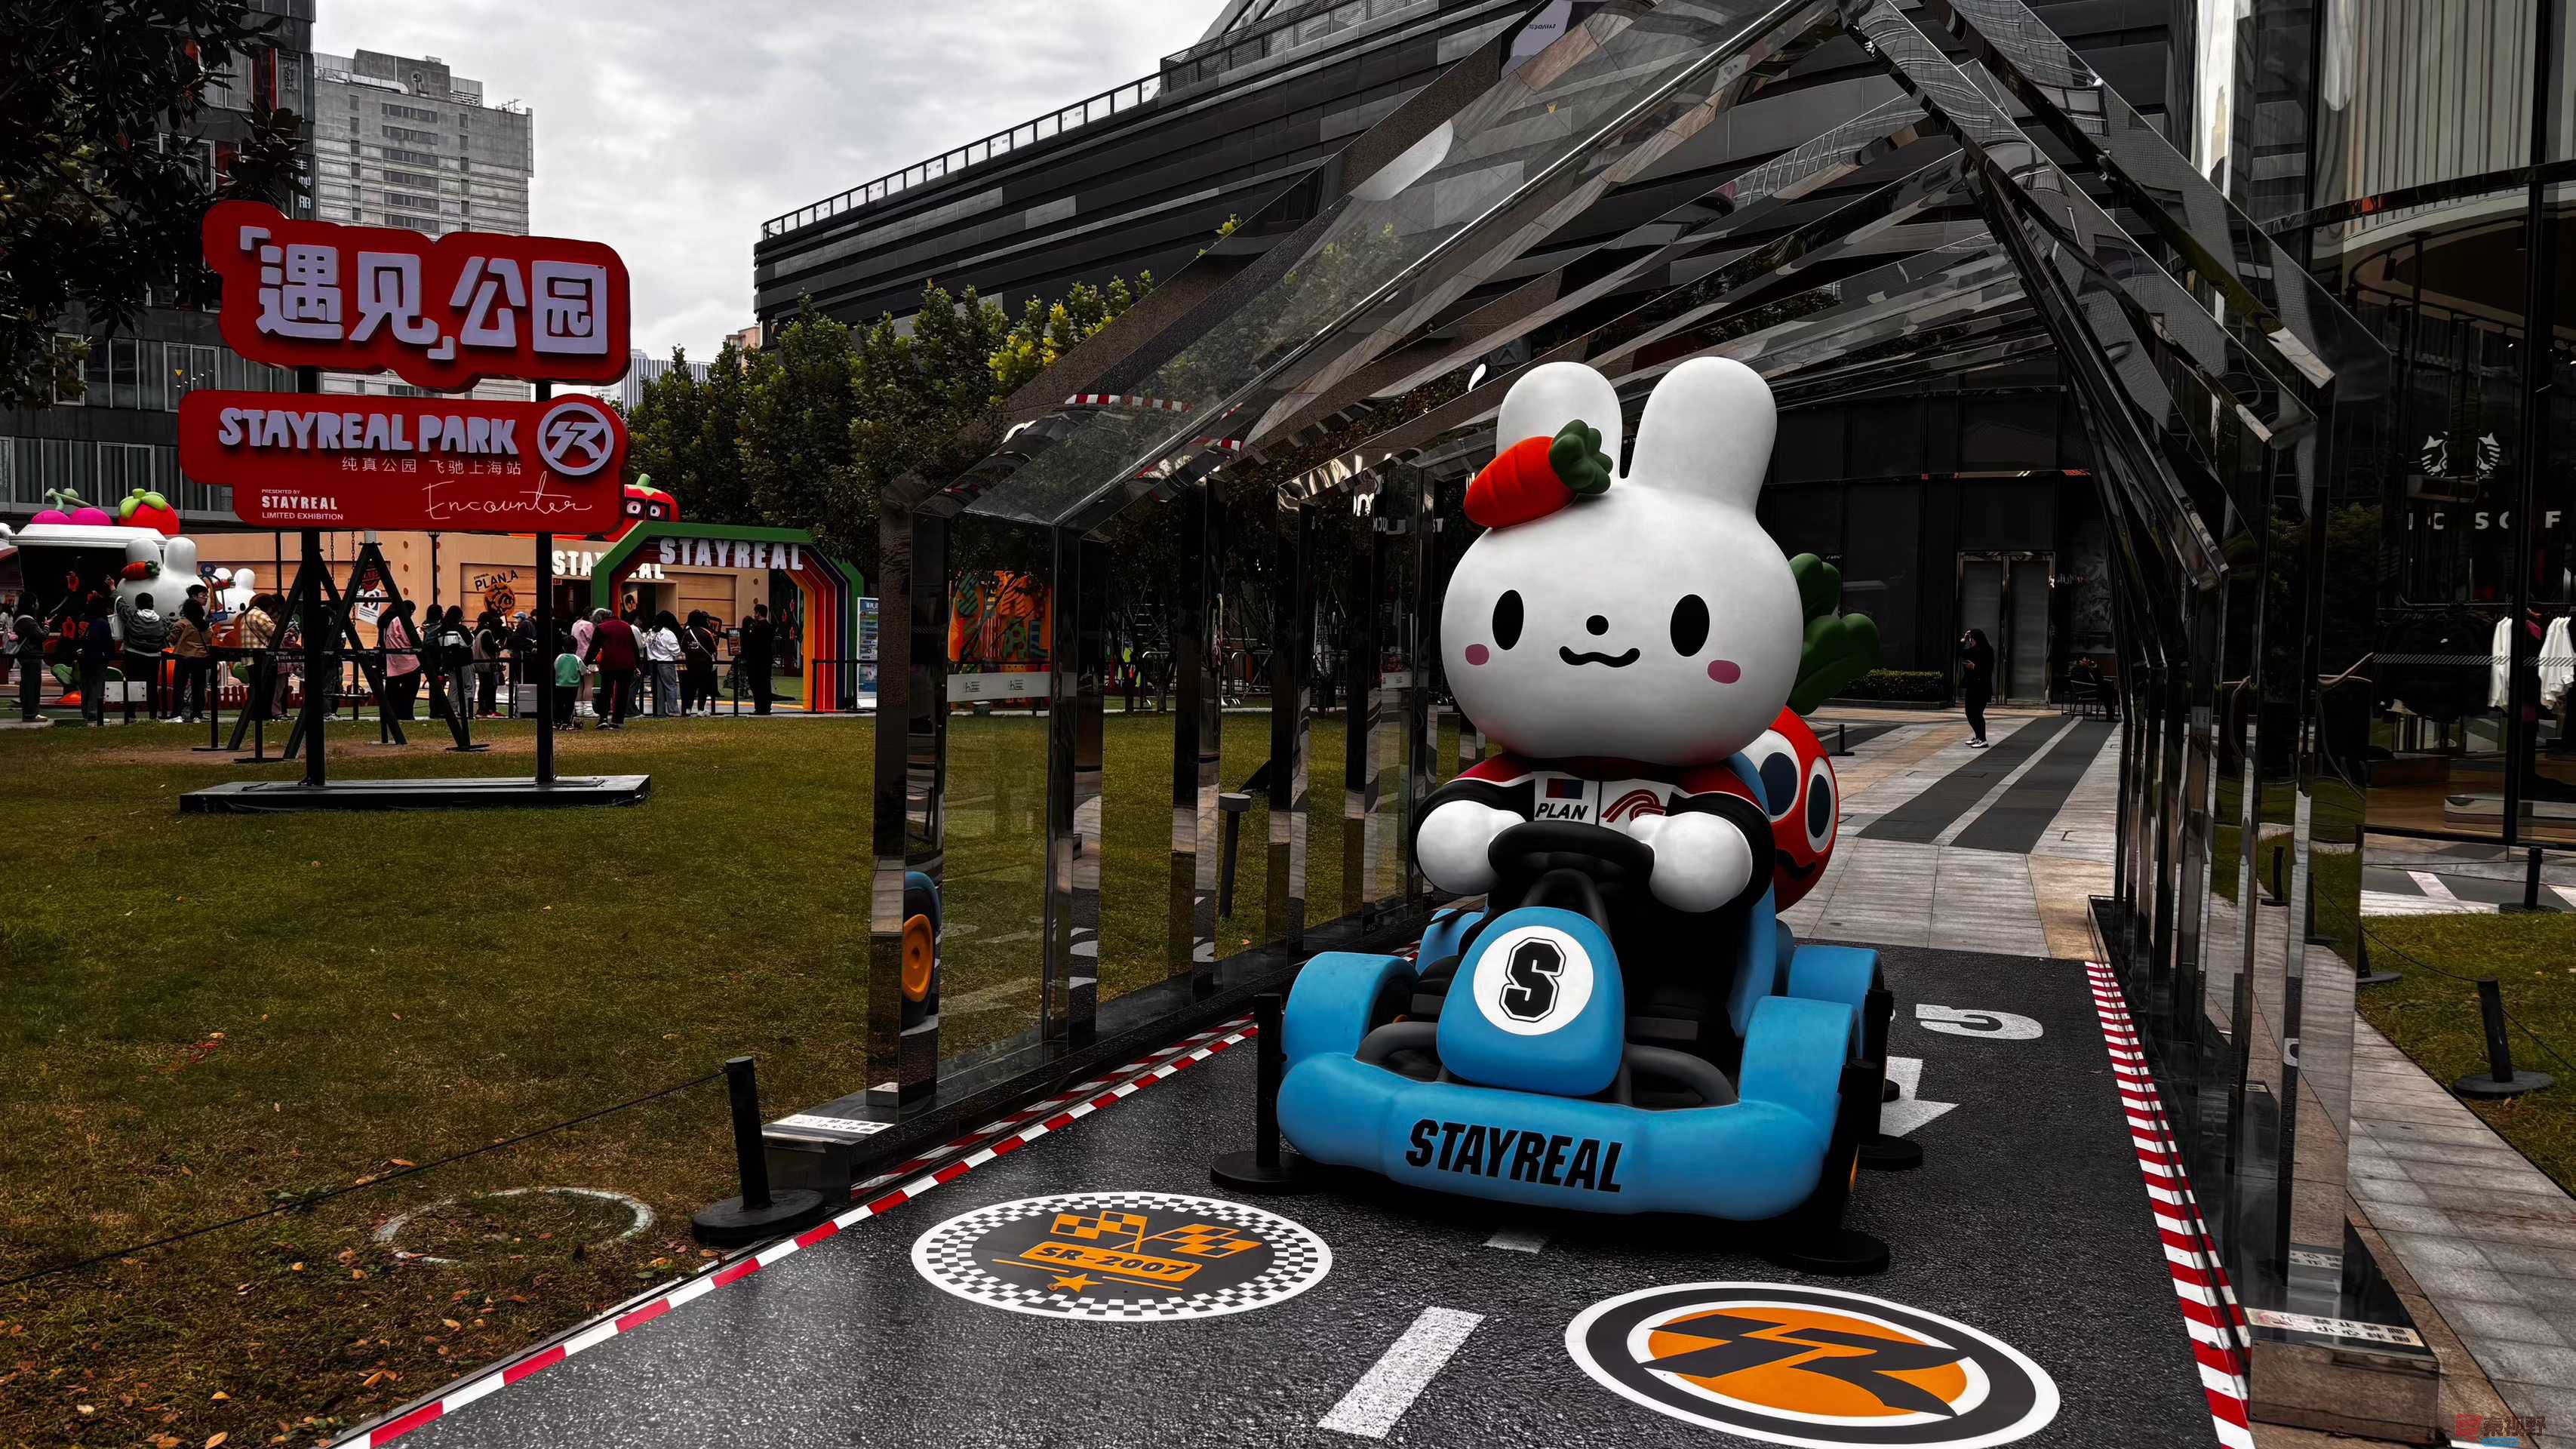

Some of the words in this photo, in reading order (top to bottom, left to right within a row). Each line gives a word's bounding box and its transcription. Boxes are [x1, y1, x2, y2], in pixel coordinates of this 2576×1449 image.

[219, 408, 414, 451] STAYREAL
[419, 415, 520, 455] PARK
[342, 457, 417, 473] 纯真公园
[429, 460, 521, 475] 飞驰上海站
[262, 496, 338, 510] STAYREAL
[422, 471, 592, 520] Encounter
[659, 537, 804, 571] STAYREAL
[1535, 803, 1588, 820] PLAN
[1499, 937, 1566, 1023] S
[1405, 1118, 1623, 1193] STAYREAL
[1035, 1246, 1194, 1275] SR-2007
